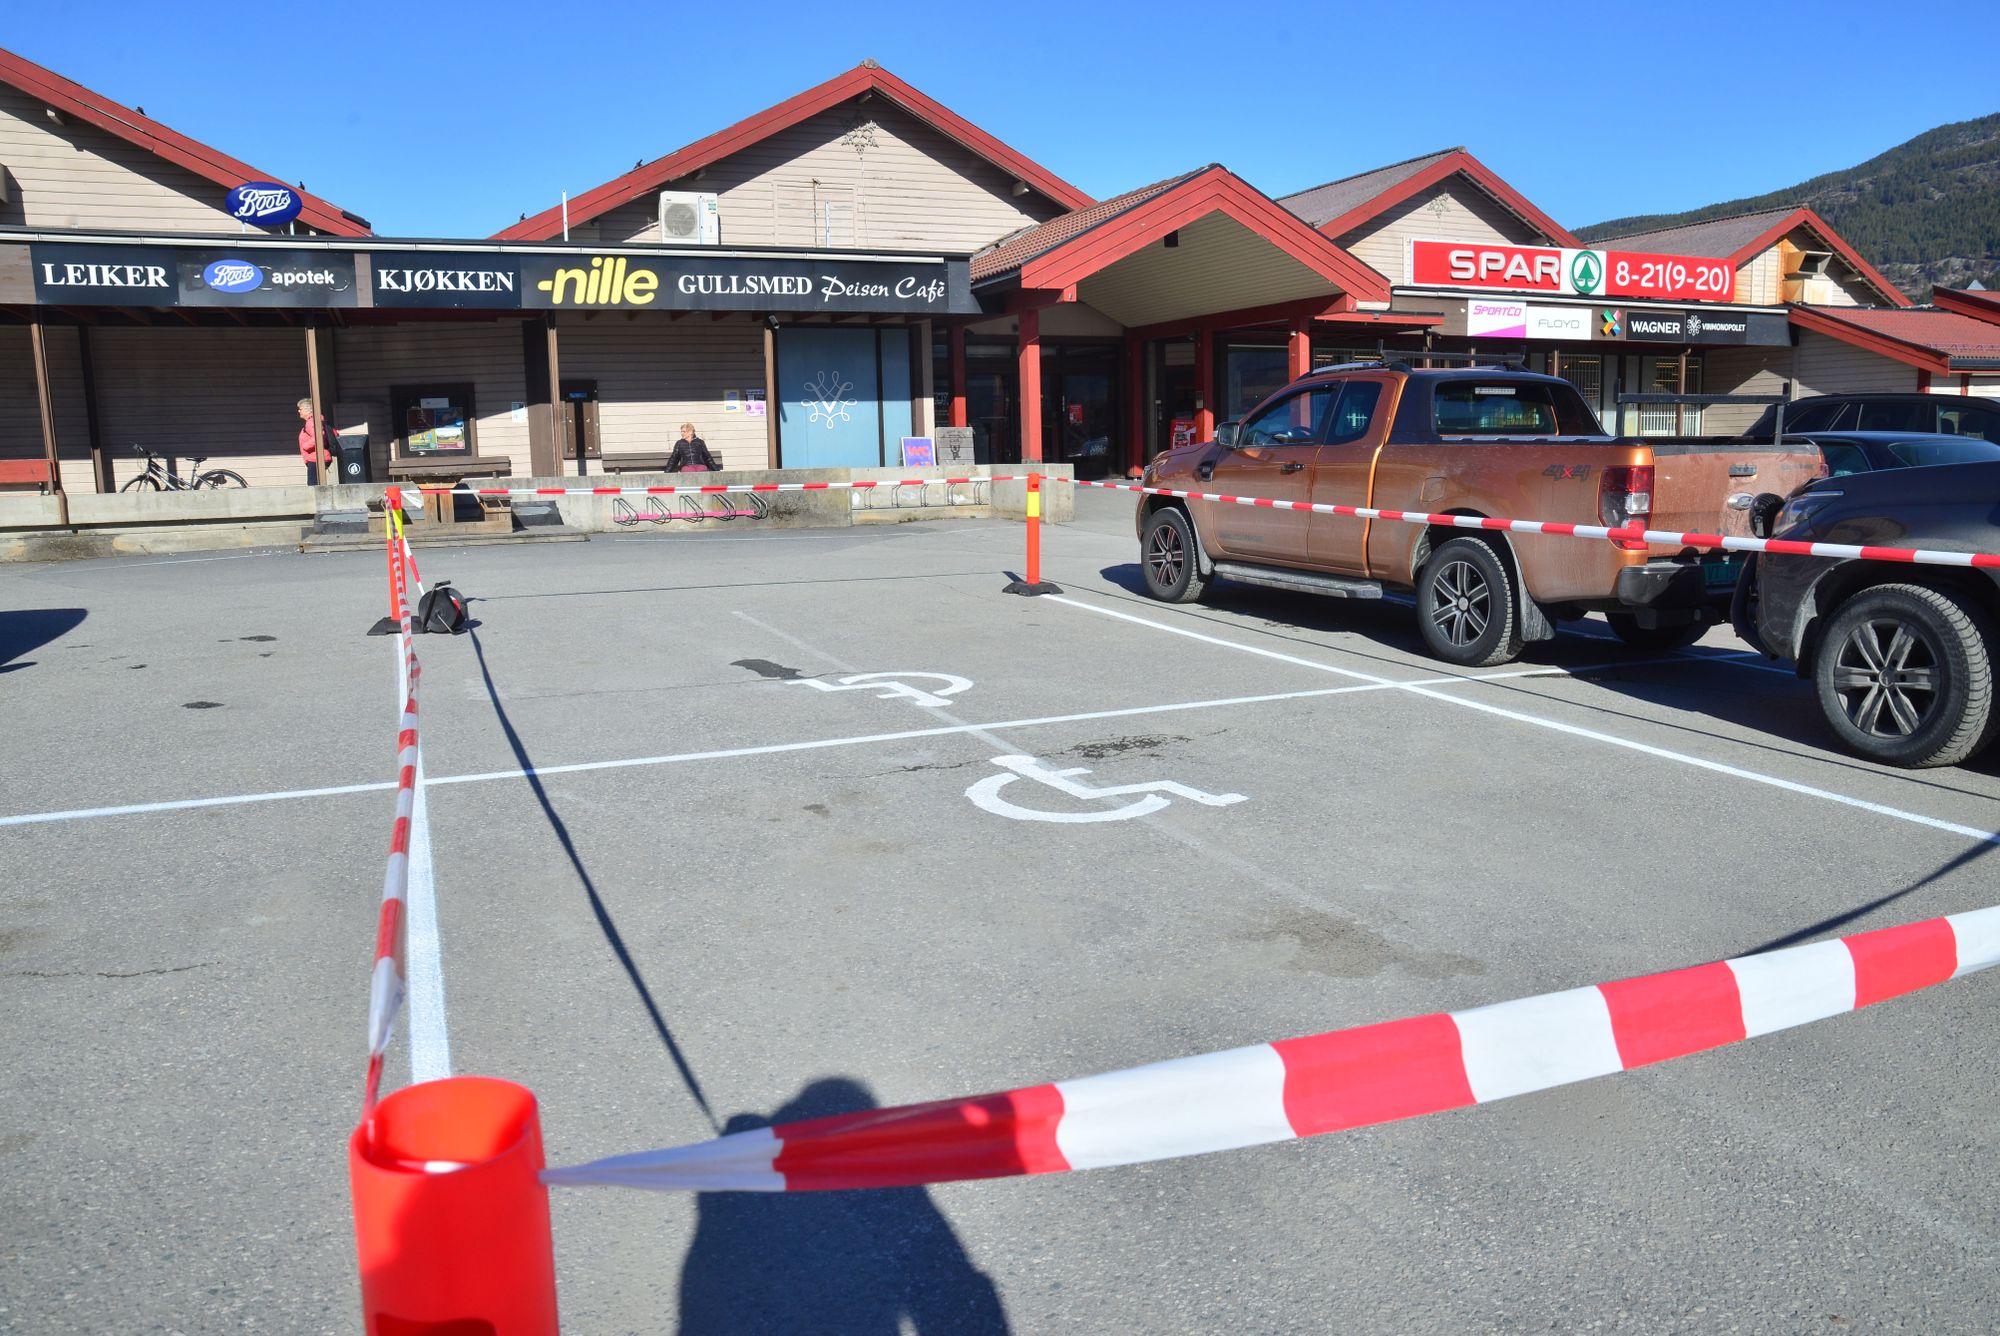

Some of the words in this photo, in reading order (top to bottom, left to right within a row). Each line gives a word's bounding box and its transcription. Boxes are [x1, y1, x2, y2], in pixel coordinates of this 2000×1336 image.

[234, 189, 292, 217] Boots
[42, 262, 170, 288] LEIKER
[210, 264, 256, 287] Boots
[271, 269, 335, 286] apotek
[1449, 250, 1561, 284] SPAR
[1615, 262, 1731, 295] 8-21(9-20)
[377, 268, 514, 292] KJØKKEN
[677, 274, 813, 295] GULLSMED
[820, 275, 890, 303] Peisen
[1631, 320, 1681, 334] WAGNER
[1702, 322, 1746, 332] VINMONOPOLET
